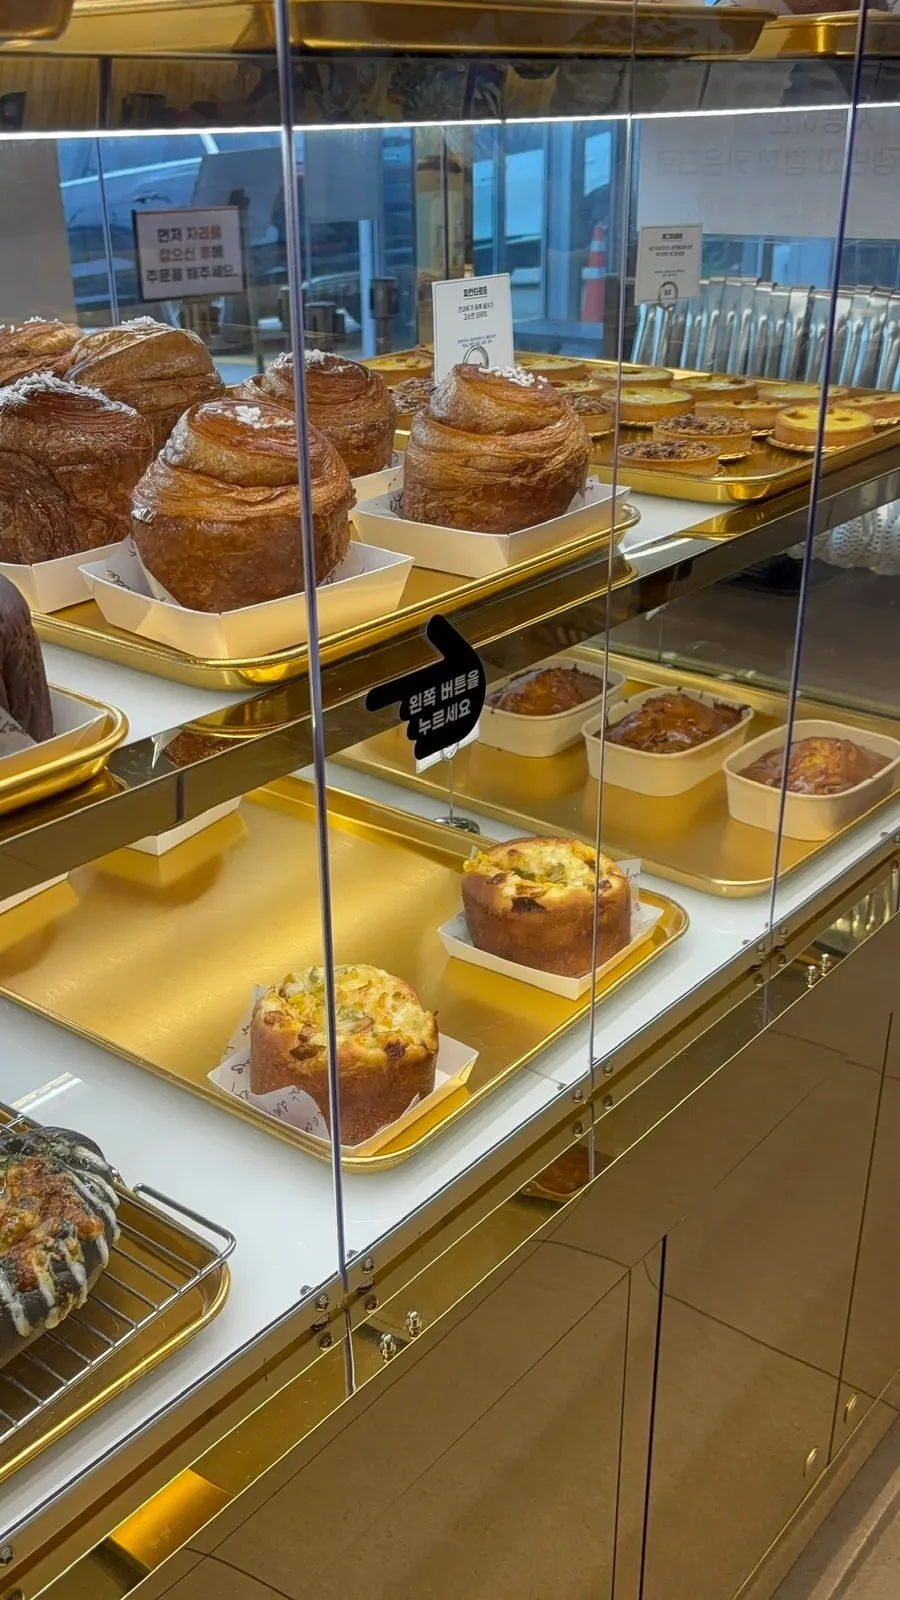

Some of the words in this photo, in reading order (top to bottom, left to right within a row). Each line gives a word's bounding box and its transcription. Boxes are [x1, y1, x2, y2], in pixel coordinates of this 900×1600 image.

[158, 228, 181, 243] 먼저
[187, 225, 221, 240] 자리를
[146, 268, 182, 283] 주문을
[409, 687, 436, 715] 왼쪽
[441, 669, 479, 701] 버튼을
[418, 699, 470, 735] 누르세요
